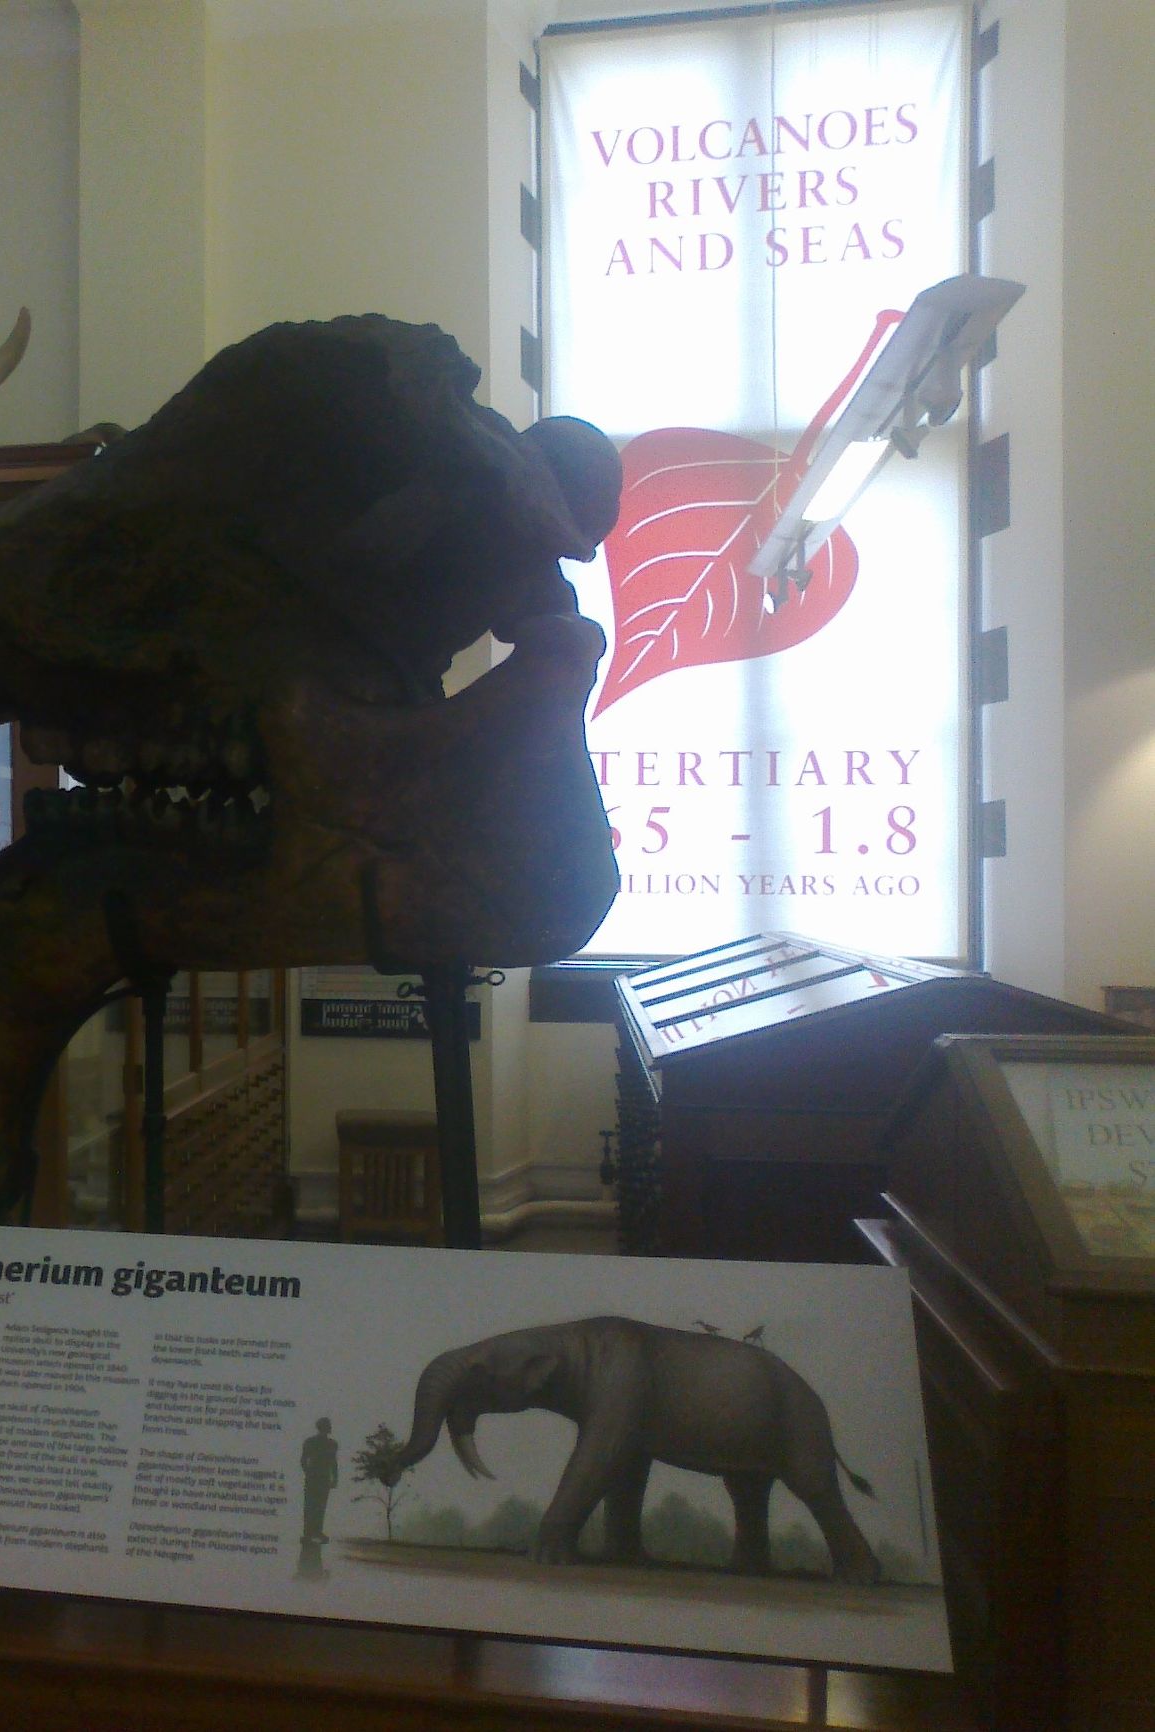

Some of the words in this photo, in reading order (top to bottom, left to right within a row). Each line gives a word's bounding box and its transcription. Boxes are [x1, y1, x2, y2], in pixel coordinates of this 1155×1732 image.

[591, 103, 919, 168] VOLCANOES
[648, 166, 859, 219] RIVERS
[604, 231, 734, 276] AND
[766, 218, 905, 267] SEAS
[589, 750, 920, 786] TERTIARY
[812, 805, 916, 855] 1.8
[617, 874, 720, 895] ILLION
[738, 874, 835, 896] YEARS
[853, 874, 921, 897] AGO
[113, 1260, 302, 1299] giganteum
[101, 1433, 117, 1442] The
[87, 1530, 106, 1539] also
